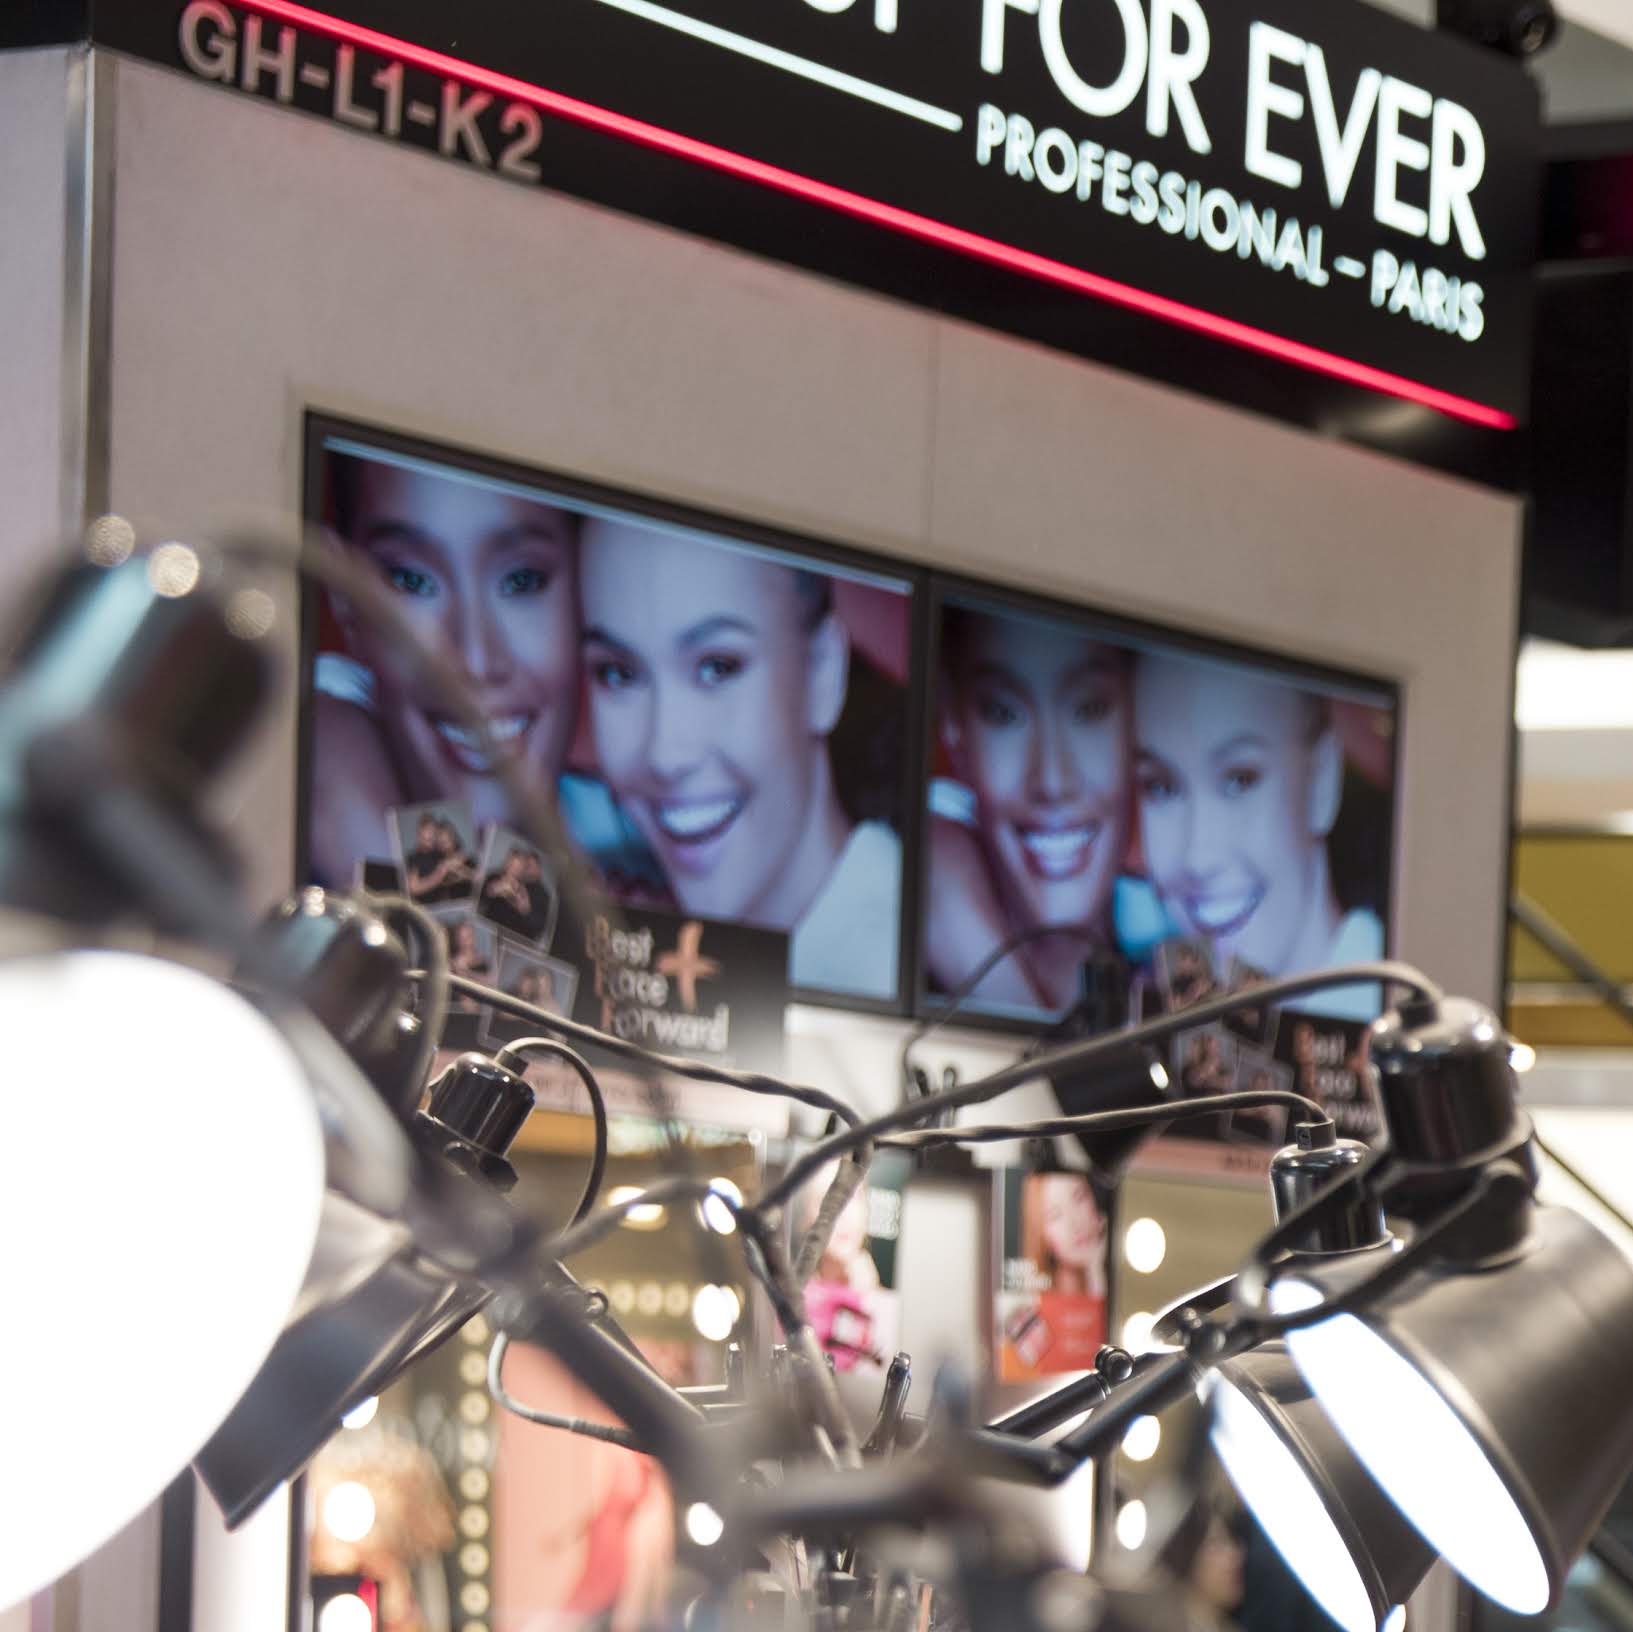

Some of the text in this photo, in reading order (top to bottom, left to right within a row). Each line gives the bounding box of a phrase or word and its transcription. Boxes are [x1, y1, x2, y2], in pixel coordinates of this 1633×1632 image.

[178, 1, 544, 180] GH-L1-K2
[1244, 20, 1486, 260] EVER
[976, 102, 1329, 289] PROFESSIONAL
[1371, 249, 1485, 343] PARIS
